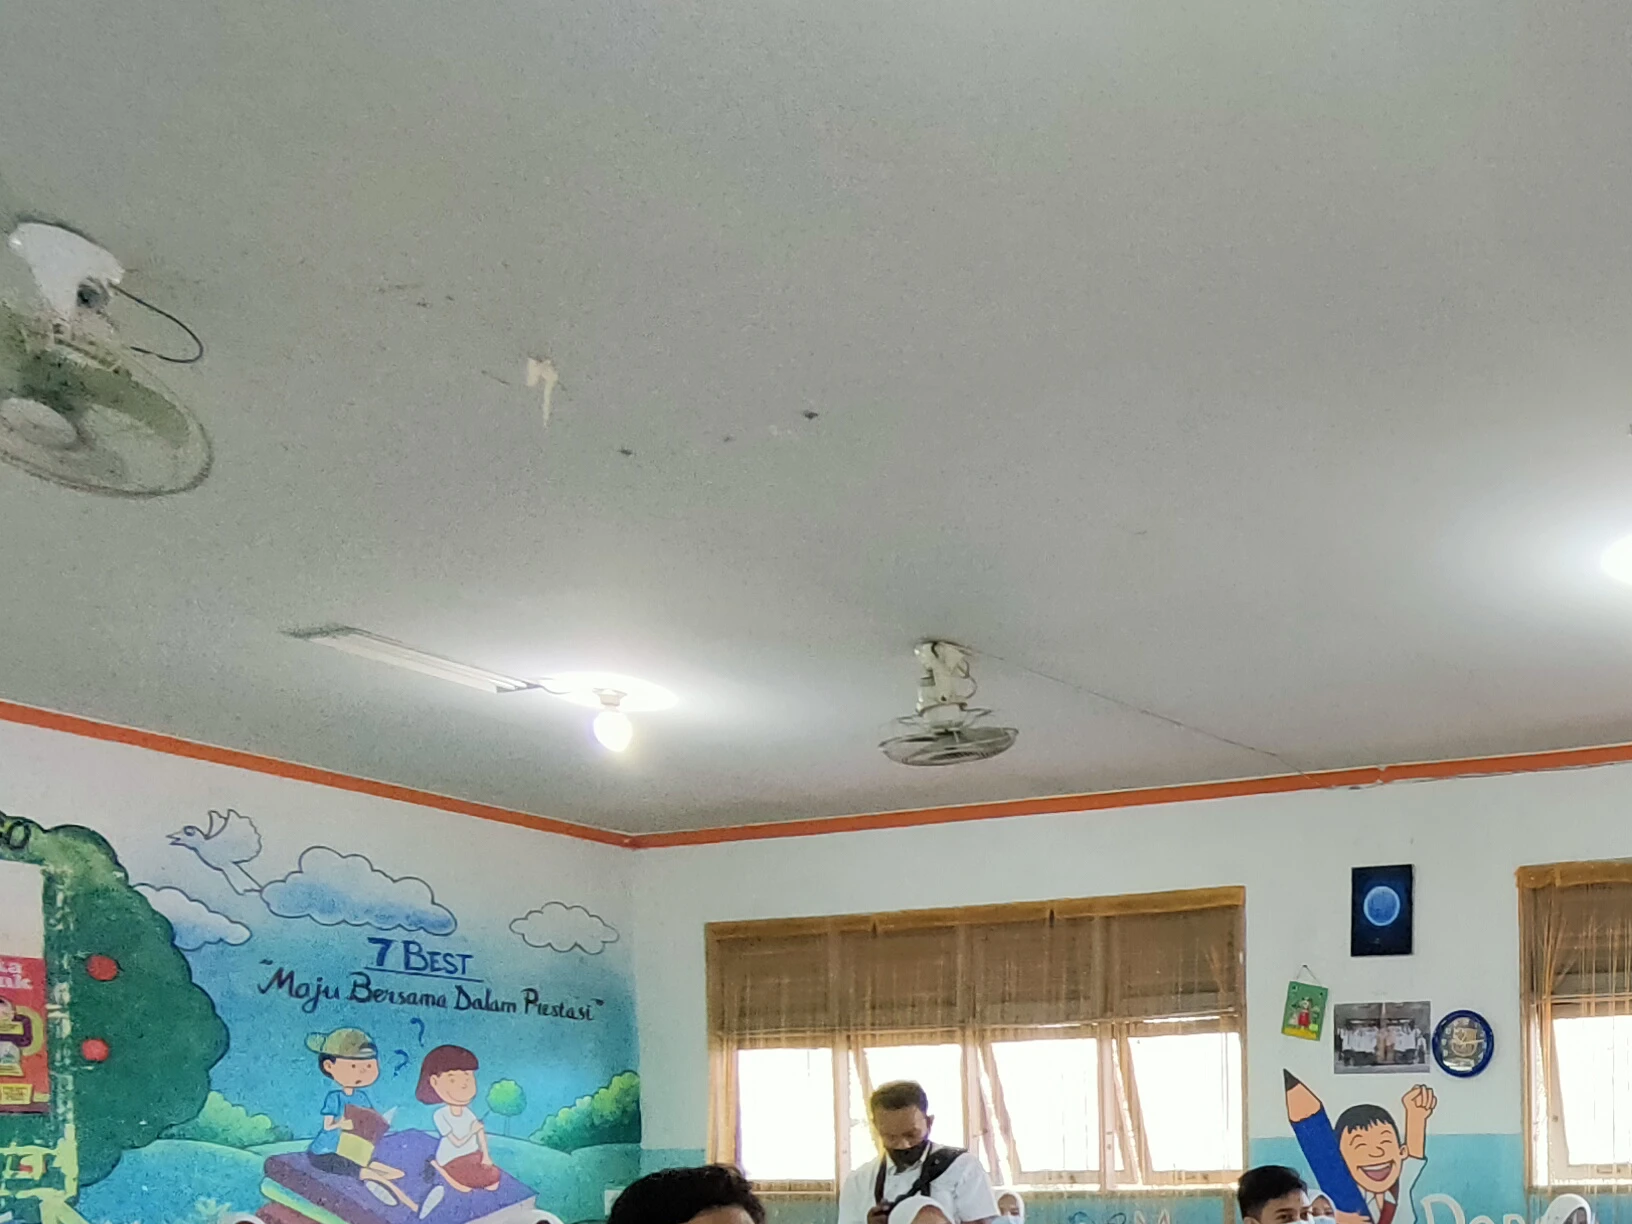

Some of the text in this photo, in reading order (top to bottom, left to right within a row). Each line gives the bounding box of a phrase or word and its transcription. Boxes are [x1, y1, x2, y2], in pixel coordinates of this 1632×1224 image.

[367, 936, 475, 976] 7 BEST
[346, 971, 447, 1009] Bersama
[454, 984, 518, 1014] Dalam
